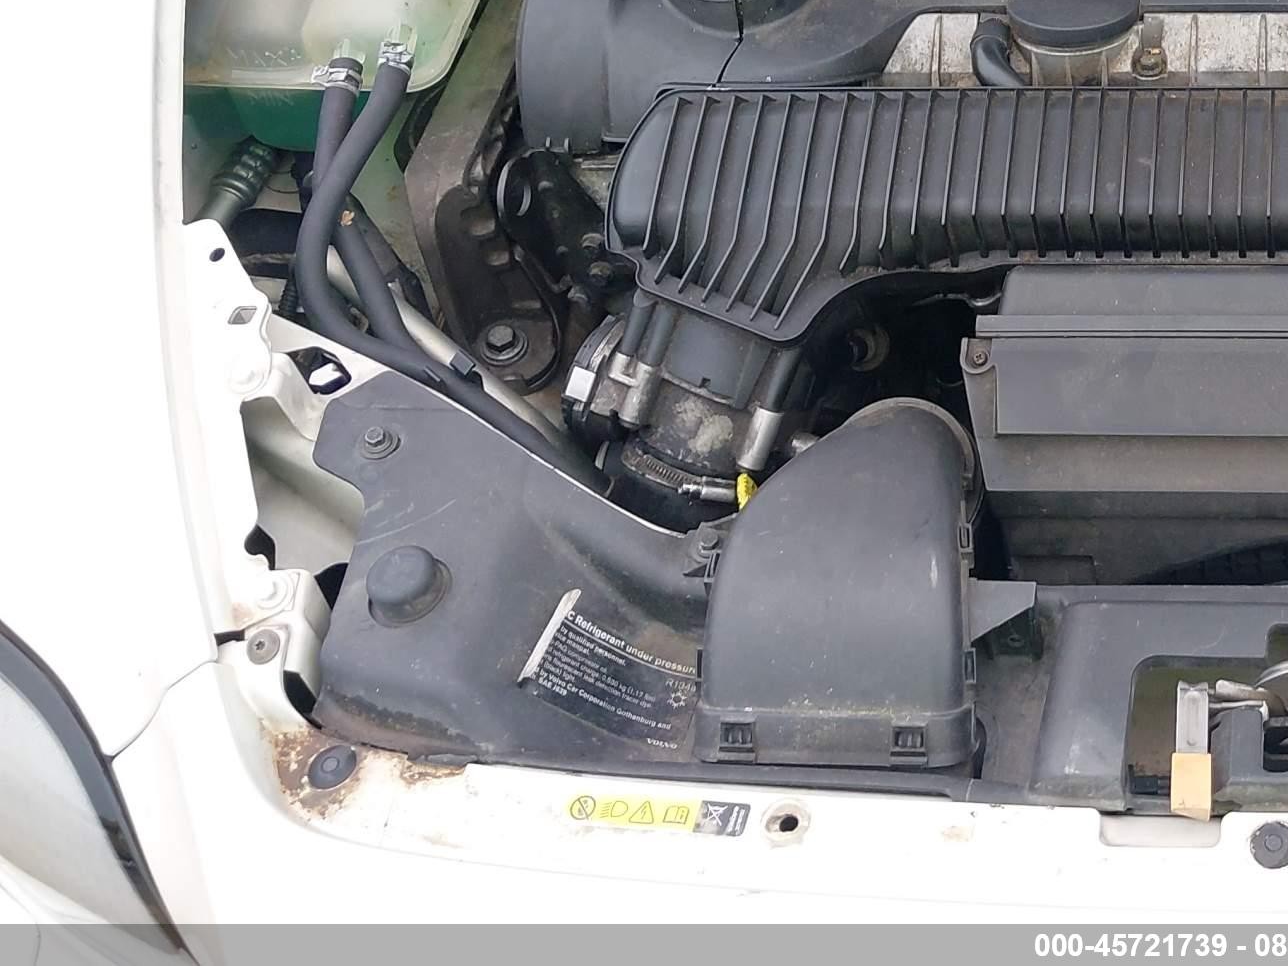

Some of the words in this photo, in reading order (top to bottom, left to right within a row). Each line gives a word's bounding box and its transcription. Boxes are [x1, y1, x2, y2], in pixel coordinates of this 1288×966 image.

[568, 631, 595, 650] qualified
[575, 614, 626, 649] Refrigerant
[625, 644, 654, 663] under
[538, 676, 553, 689] SAE
[548, 673, 567, 689] Volvo
[566, 682, 580, 694] Car
[578, 689, 616, 713] Corporation
[616, 707, 657, 729] Gothenburg
[657, 721, 673, 731] and
[646, 737, 679, 750] VOLVO
